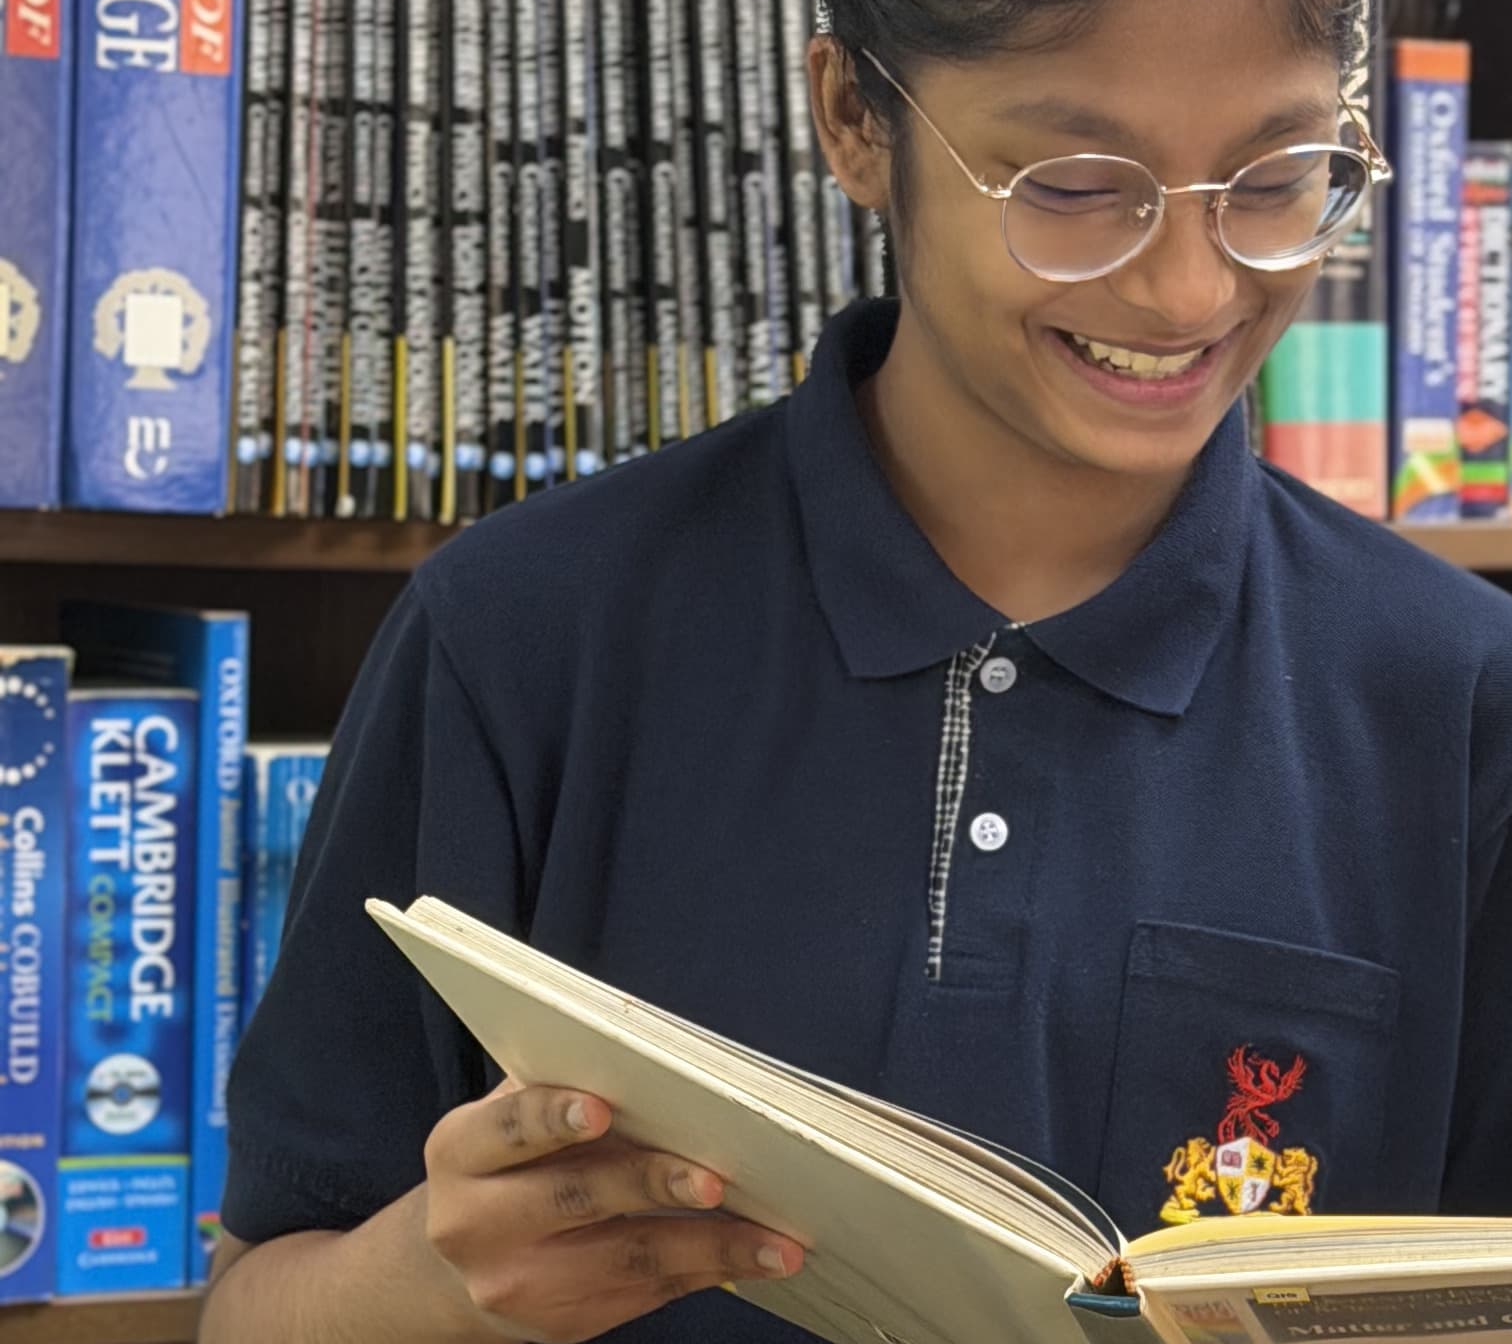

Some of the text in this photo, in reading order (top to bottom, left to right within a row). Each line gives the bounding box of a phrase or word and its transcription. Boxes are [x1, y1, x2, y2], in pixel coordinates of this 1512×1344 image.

[1422, 91, 1458, 386] Oxford Student's
[1481, 206, 1508, 404] DICTIONARY
[489, 314, 515, 425] WATER
[522, 314, 546, 425] WATER
[569, 265, 595, 405] MOTION
[217, 657, 241, 790] OXFORD
[9, 807, 45, 1084] Collins COBUILD
[86, 718, 132, 1023] KLETT COMPACT
[130, 716, 177, 1022] CAMBRIDGE
[1287, 1321, 1413, 1335] Matter
[1423, 1314, 1489, 1331] and
